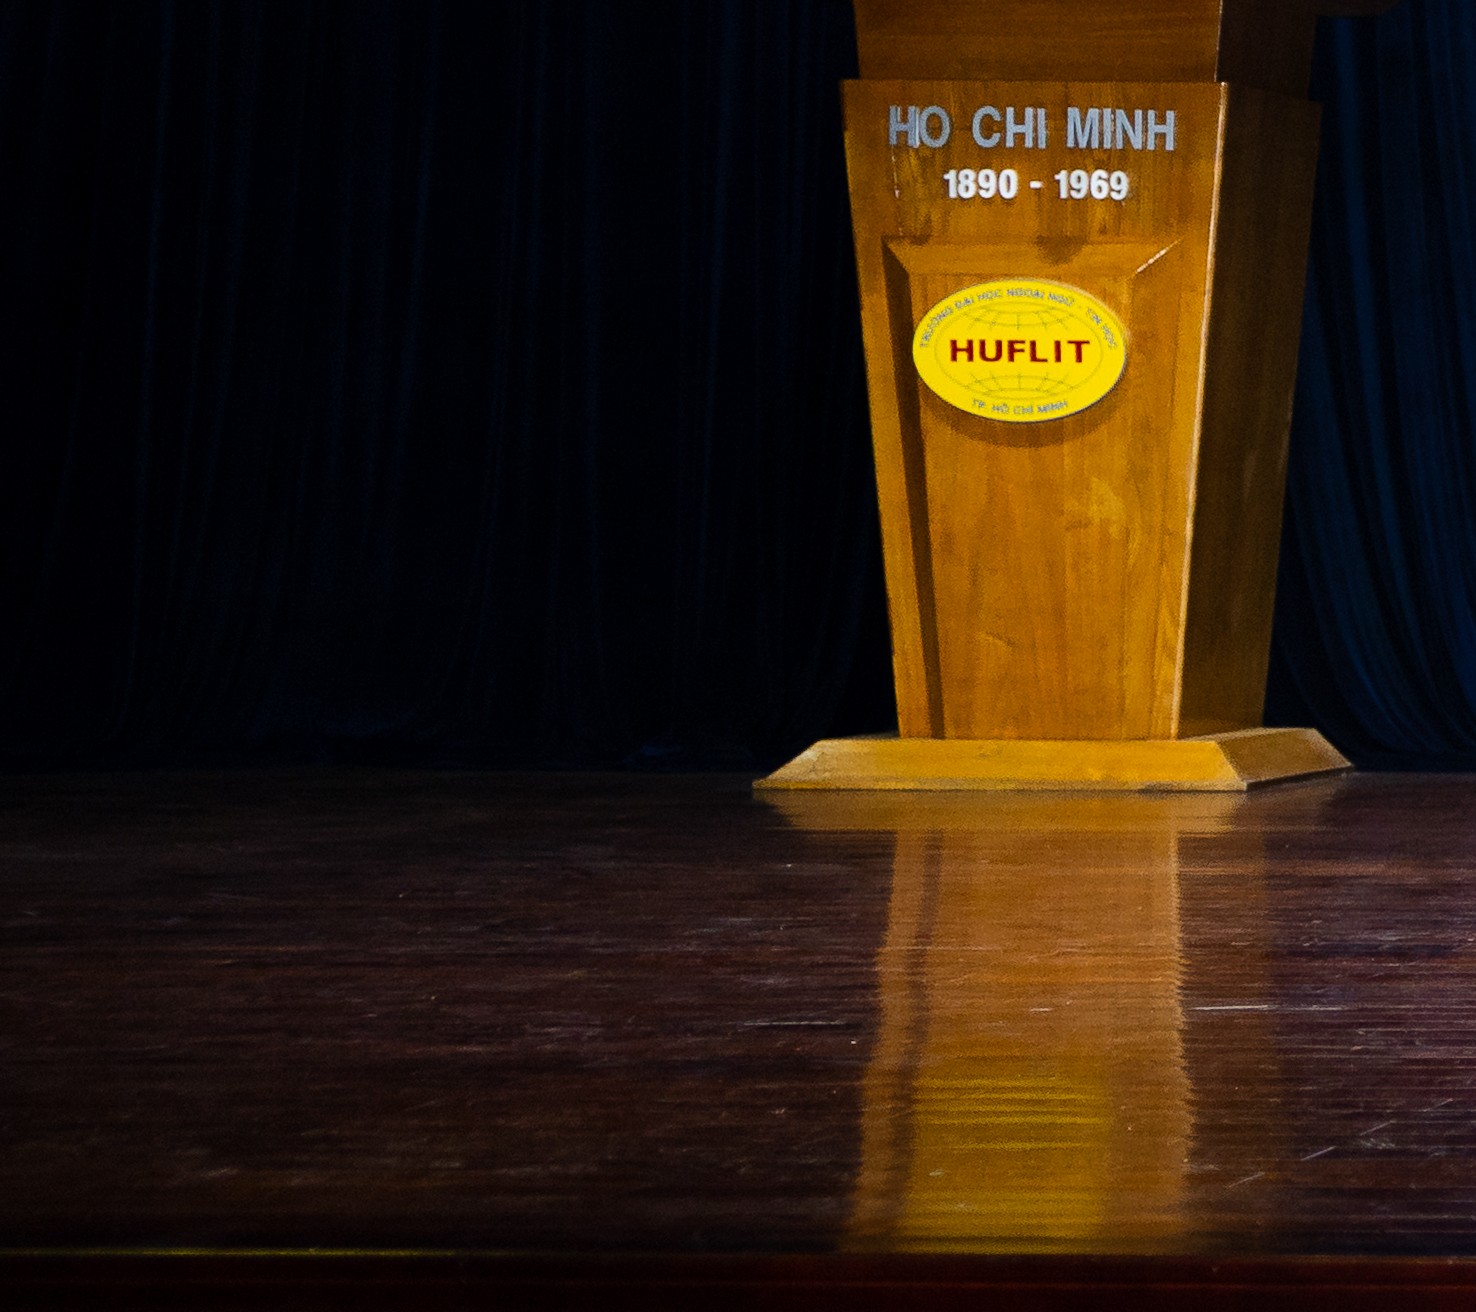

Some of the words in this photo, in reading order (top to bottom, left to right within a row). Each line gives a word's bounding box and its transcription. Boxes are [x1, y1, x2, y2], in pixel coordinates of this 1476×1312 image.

[889, 106, 950, 148] HO
[972, 107, 1047, 149] CHI
[1066, 108, 1176, 151] MINH
[944, 168, 1018, 199] 1890
[1055, 170, 1129, 201] 1969
[950, 339, 1089, 363] HUFLIT
